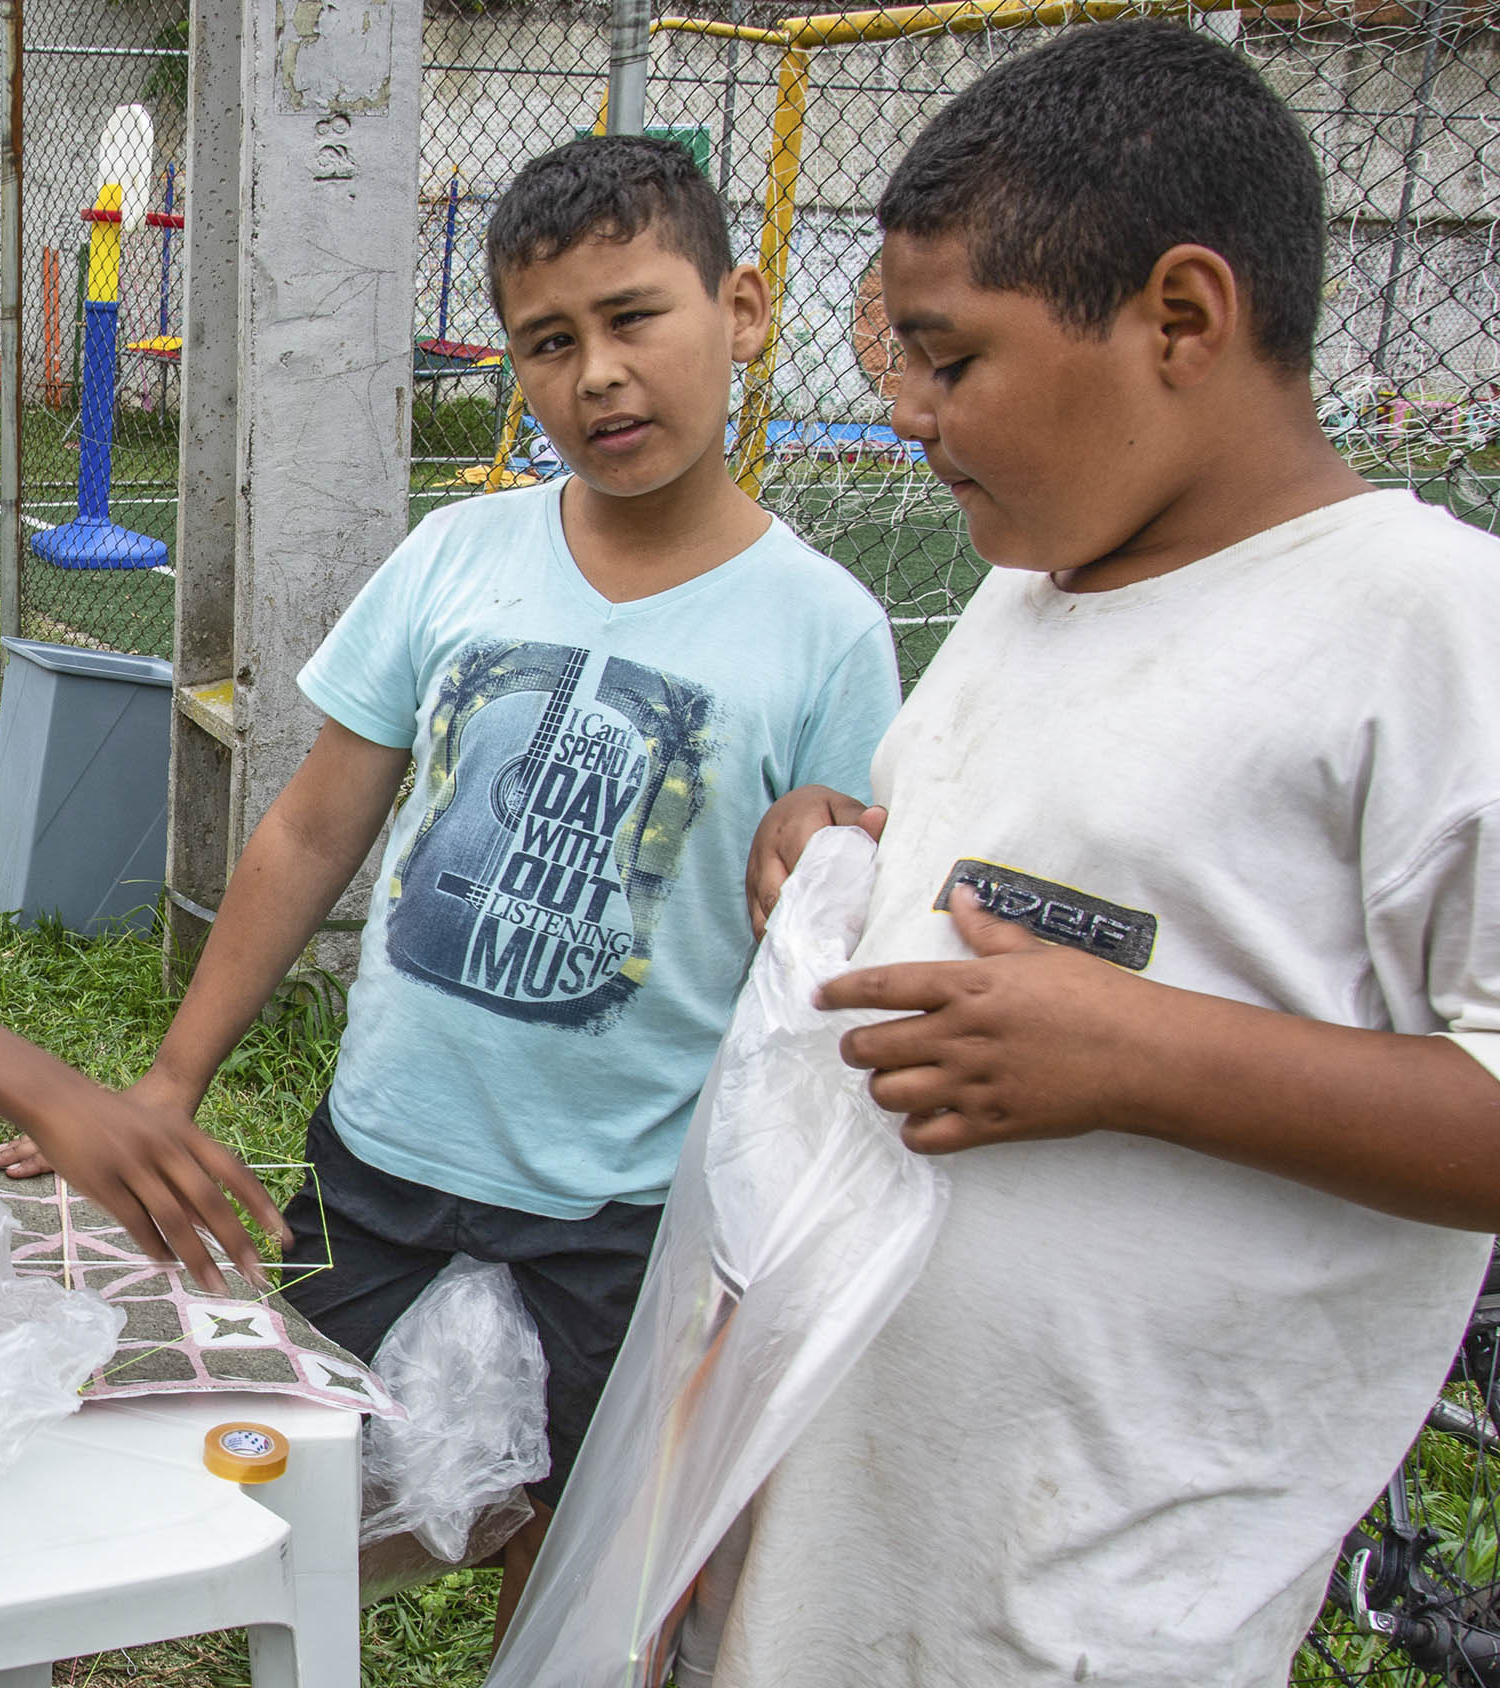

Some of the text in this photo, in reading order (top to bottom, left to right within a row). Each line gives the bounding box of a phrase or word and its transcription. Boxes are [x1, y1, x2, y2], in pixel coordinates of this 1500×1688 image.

[565, 707, 638, 750] I Can't
[554, 733, 648, 788] SPEND A
[530, 761, 641, 838] DAY
[522, 814, 613, 876] WITH
[498, 851, 622, 924] OUT
[486, 892, 633, 955] LISTENING
[466, 914, 621, 998] MUSIC
